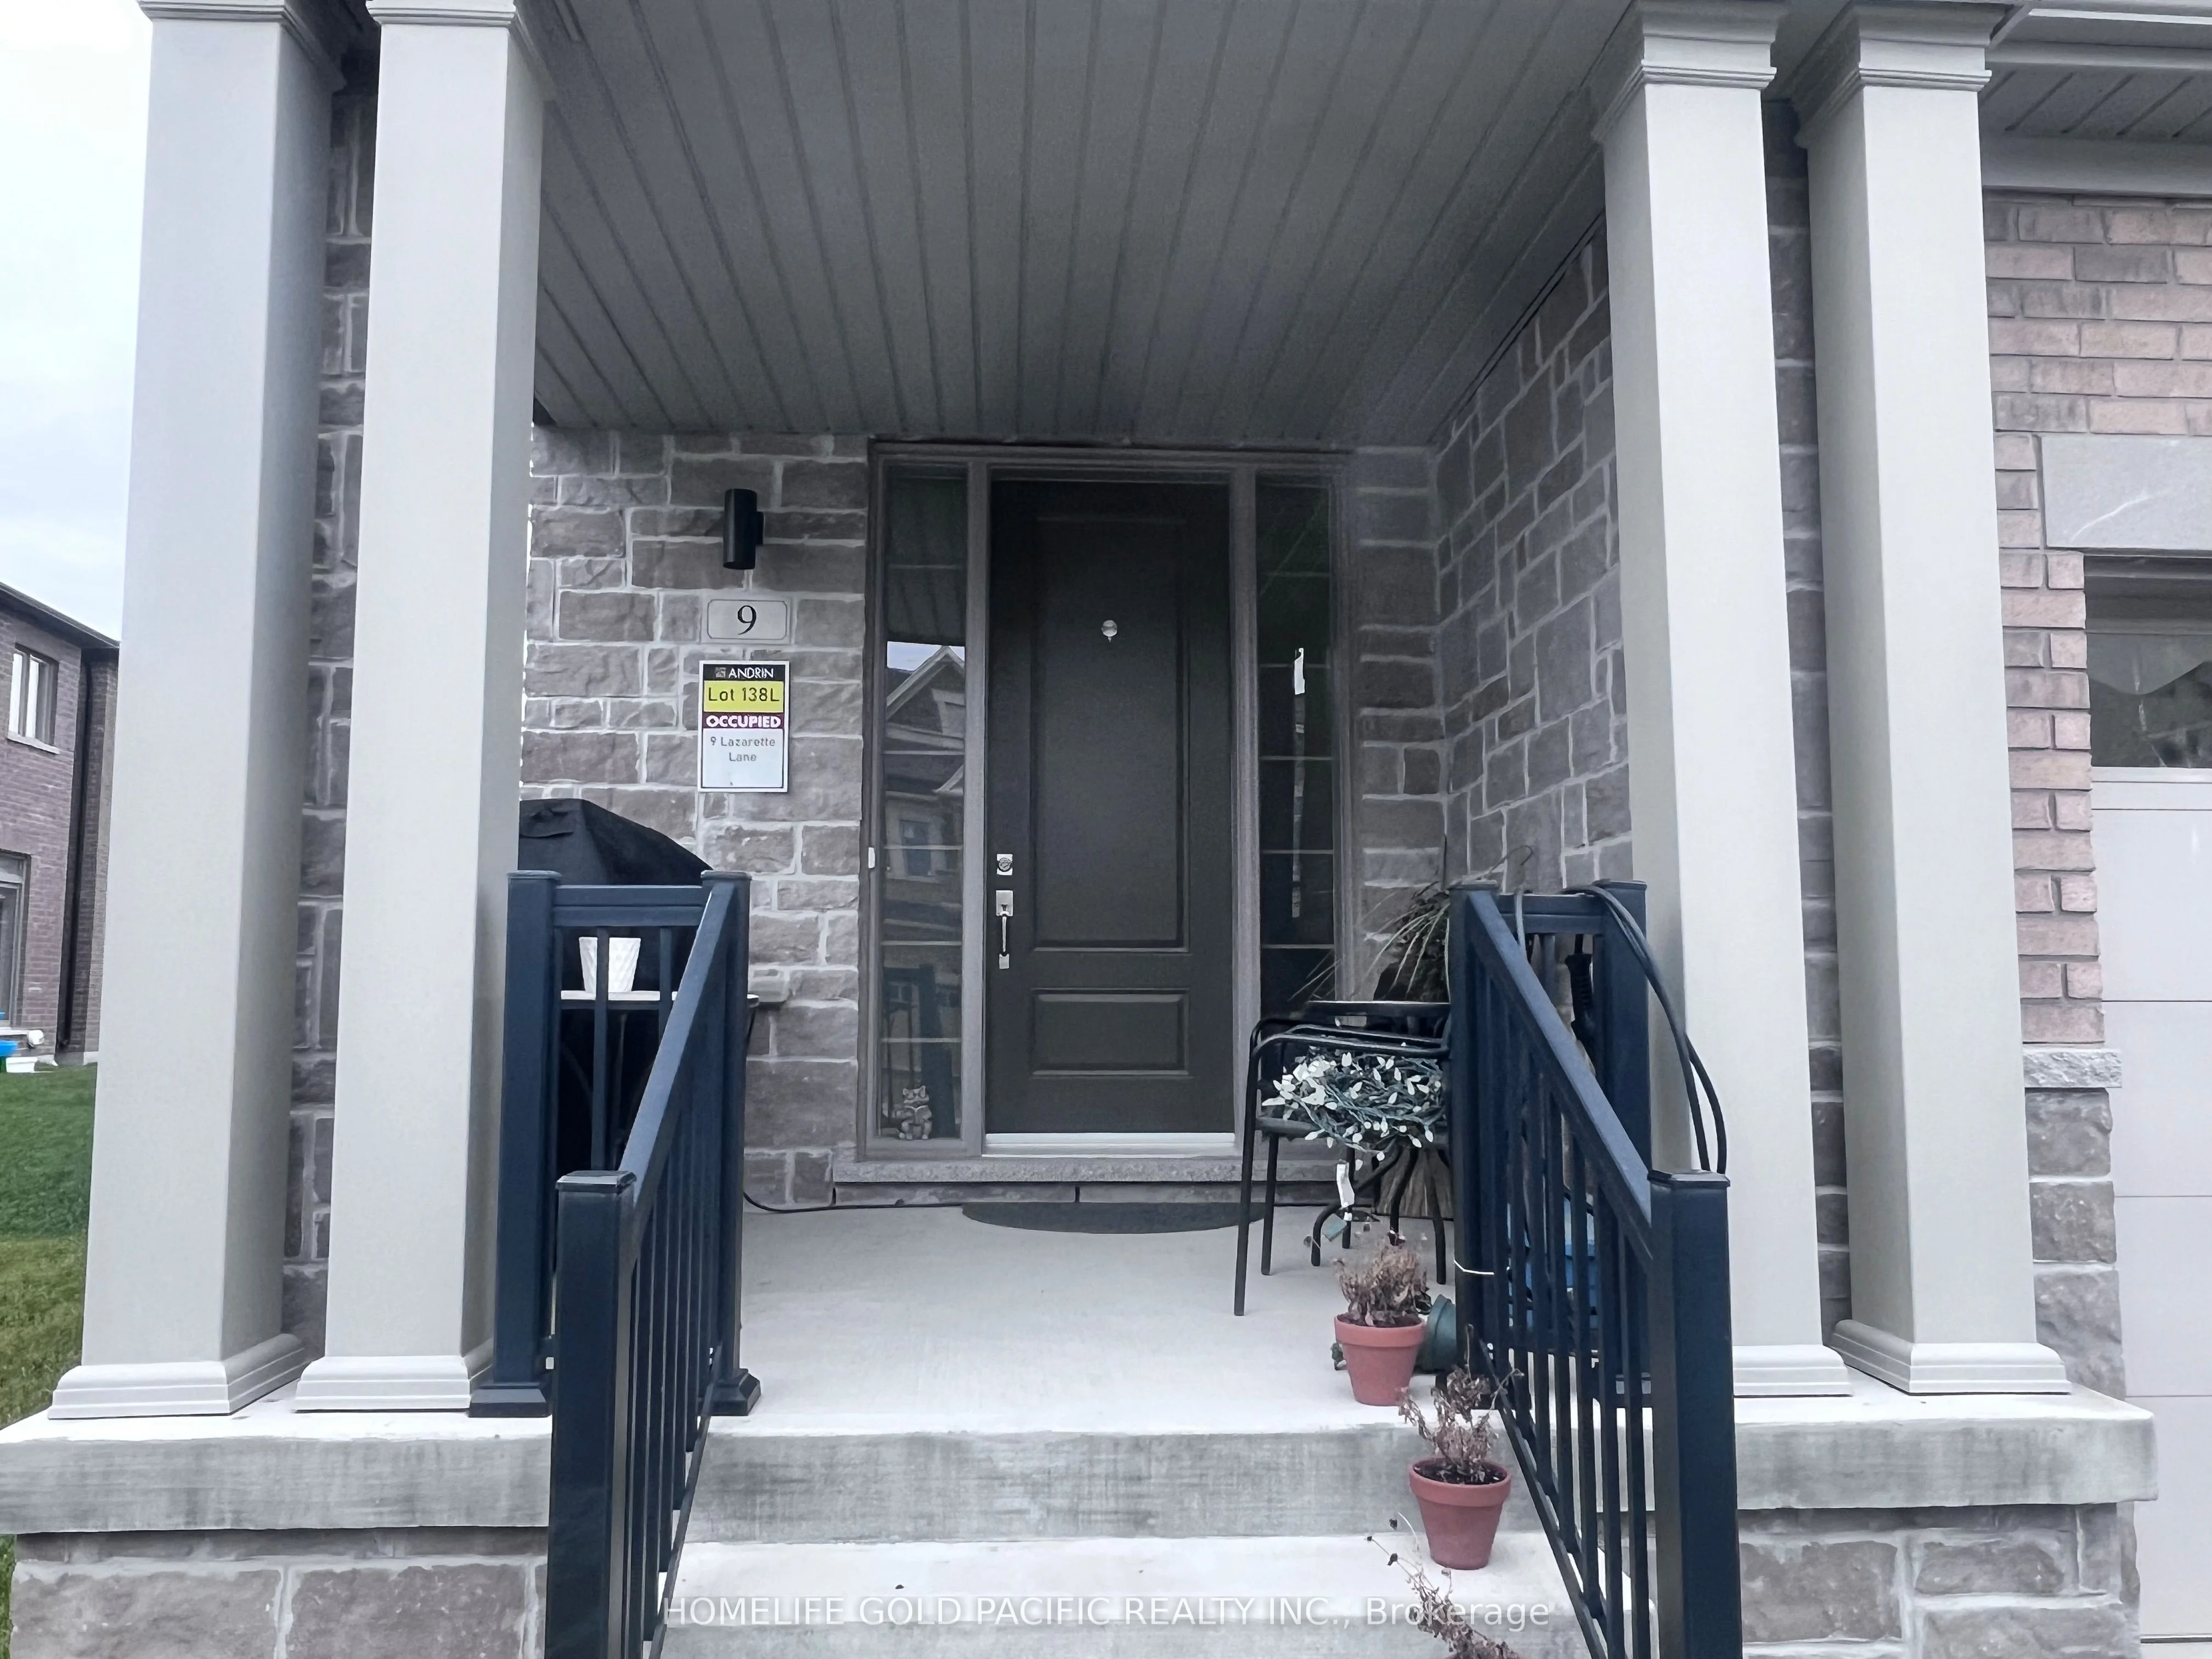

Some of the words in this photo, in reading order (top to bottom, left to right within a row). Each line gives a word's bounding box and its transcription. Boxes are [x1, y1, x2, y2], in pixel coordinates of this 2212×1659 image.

[737, 605, 757, 635] 9
[728, 667, 774, 679] ANDRIN
[708, 687, 735, 701] Lot
[742, 687, 780, 702] 138L
[706, 714, 781, 728] OCCUPIED
[710, 736, 716, 746] 9
[729, 752, 757, 761] Lane
